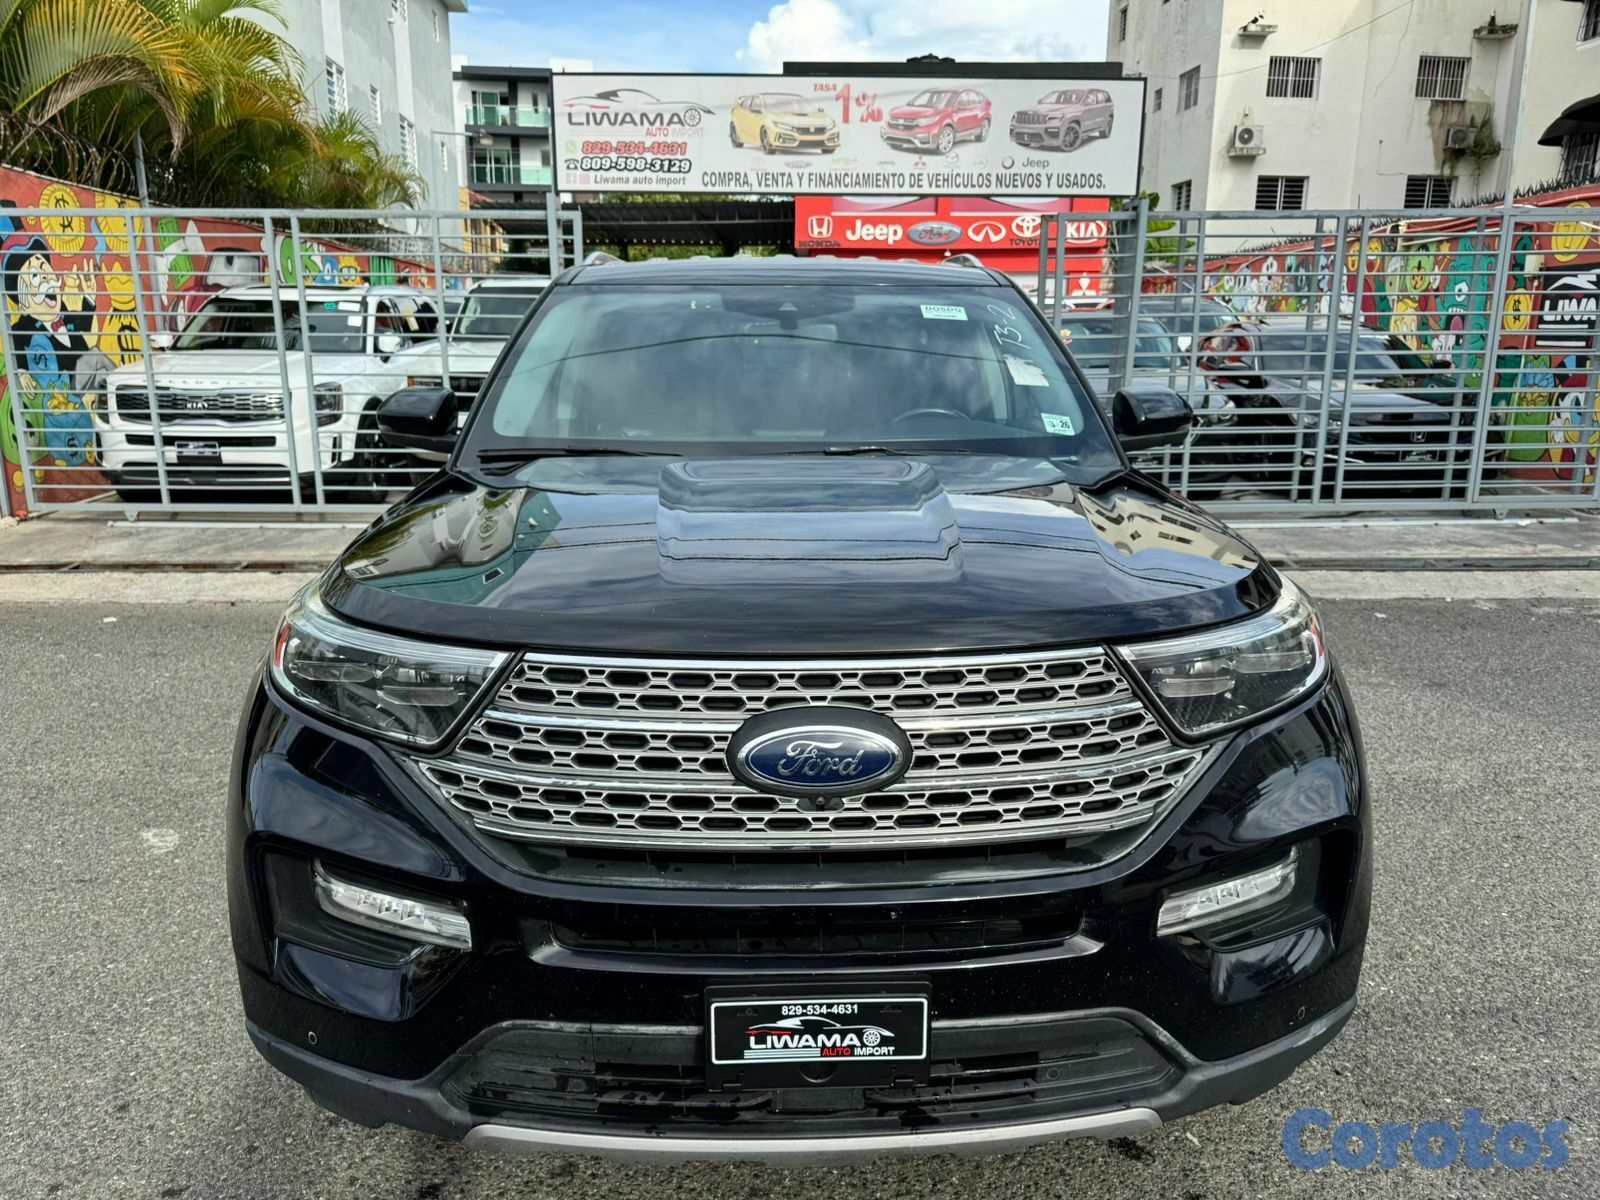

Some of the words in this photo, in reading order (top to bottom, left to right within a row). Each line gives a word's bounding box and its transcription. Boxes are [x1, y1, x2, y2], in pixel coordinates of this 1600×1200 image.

[813, 83, 837, 92] TASA
[567, 112, 686, 126] LIWAMA
[645, 127, 669, 137] AUTO
[671, 127, 704, 137] IMPORT
[582, 141, 688, 155] 829-534-4631
[581, 156, 692, 173] 809-598-3129
[1022, 157, 1050, 169] Jeep
[594, 174, 629, 185] Liwama
[632, 175, 653, 185] auto
[655, 175, 686, 187] import
[701, 171, 753, 191] COMPRA,
[756, 172, 793, 188] VENTA
[797, 172, 805, 188] Y
[808, 172, 905, 188] FINANCIAMIENTO
[909, 172, 923, 188] DE
[927, 169, 992, 188] VEHÍCULOS
[995, 172, 1042, 188] NUEVOS
[1045, 172, 1053, 188] Y
[1056, 172, 1106, 189] USADOS.
[845, 219, 903, 245] Jeep
[1066, 221, 1099, 238] KIA
[778, 740, 864, 777] Ford
[781, 1004, 859, 1015] 829-534-4631
[749, 1033, 861, 1049] LIWAMA
[822, 1047, 851, 1057] AUTO
[854, 1046, 895, 1056] IMPORT
